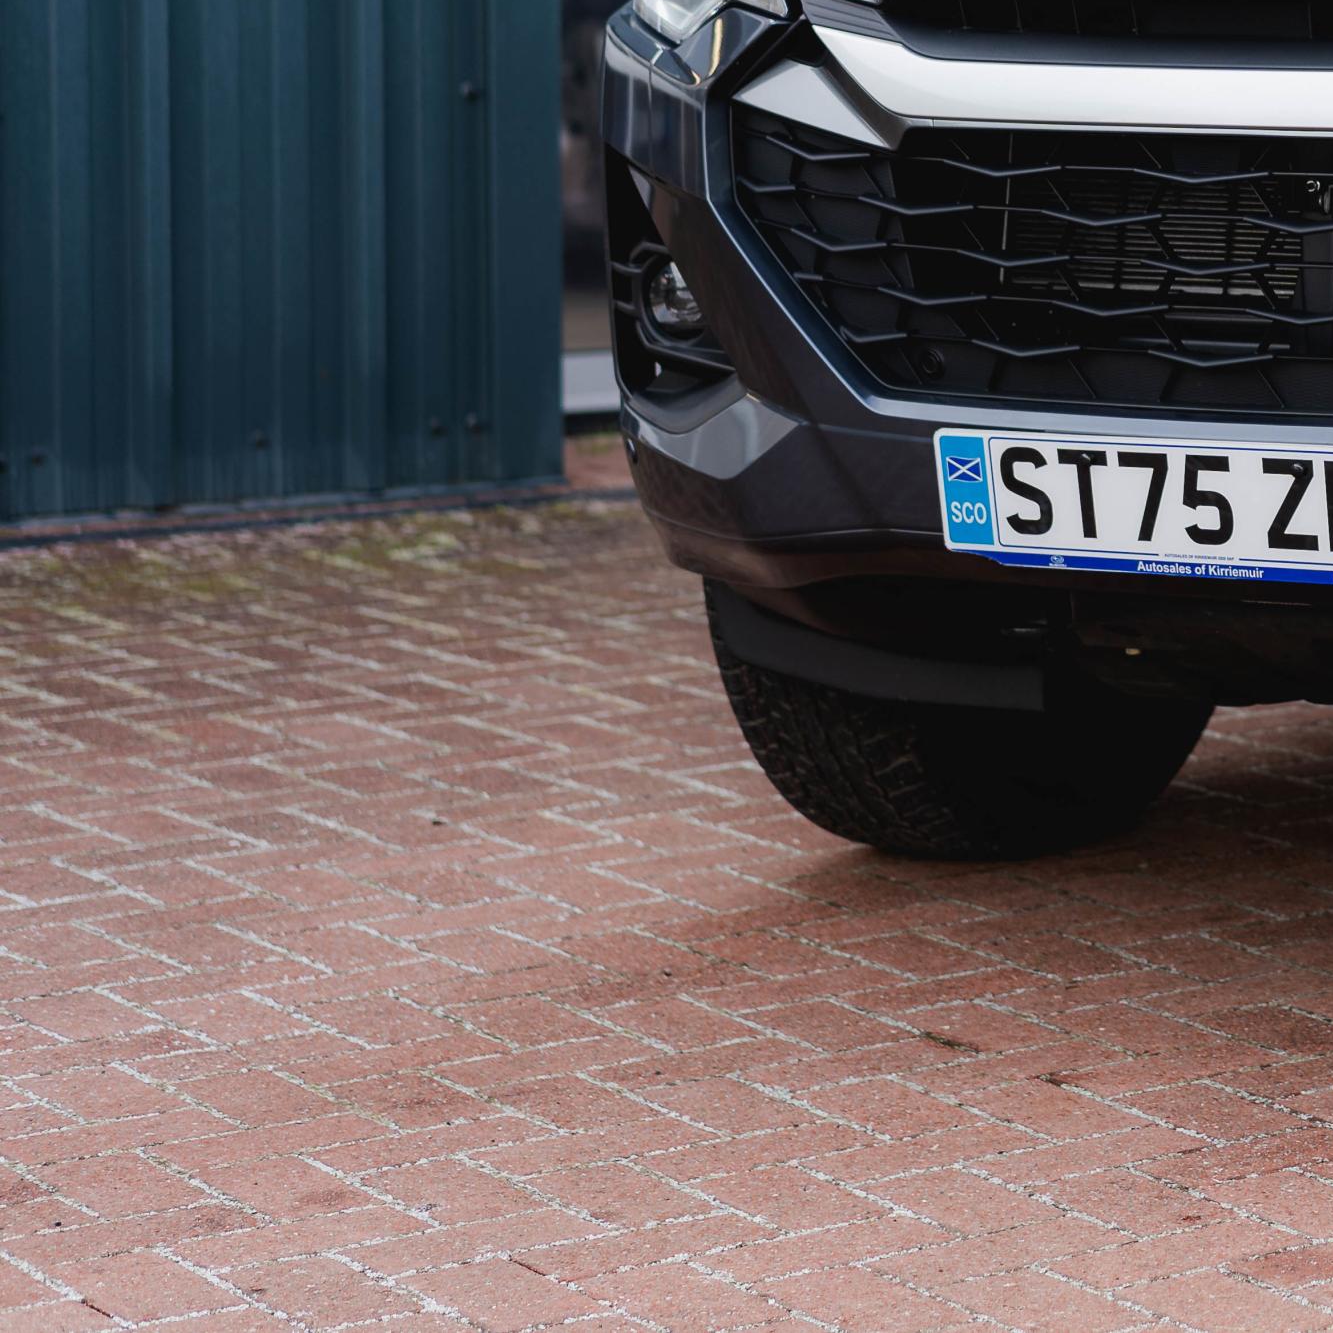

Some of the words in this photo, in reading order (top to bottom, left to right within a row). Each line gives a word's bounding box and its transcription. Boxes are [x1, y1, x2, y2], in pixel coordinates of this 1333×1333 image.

[998, 446, 1236, 546] ST75
[950, 500, 987, 525] SCO
[1137, 560, 1192, 575] Autosales
[1194, 564, 1206, 575] of
[1208, 564, 1265, 579] Kirriemuir
